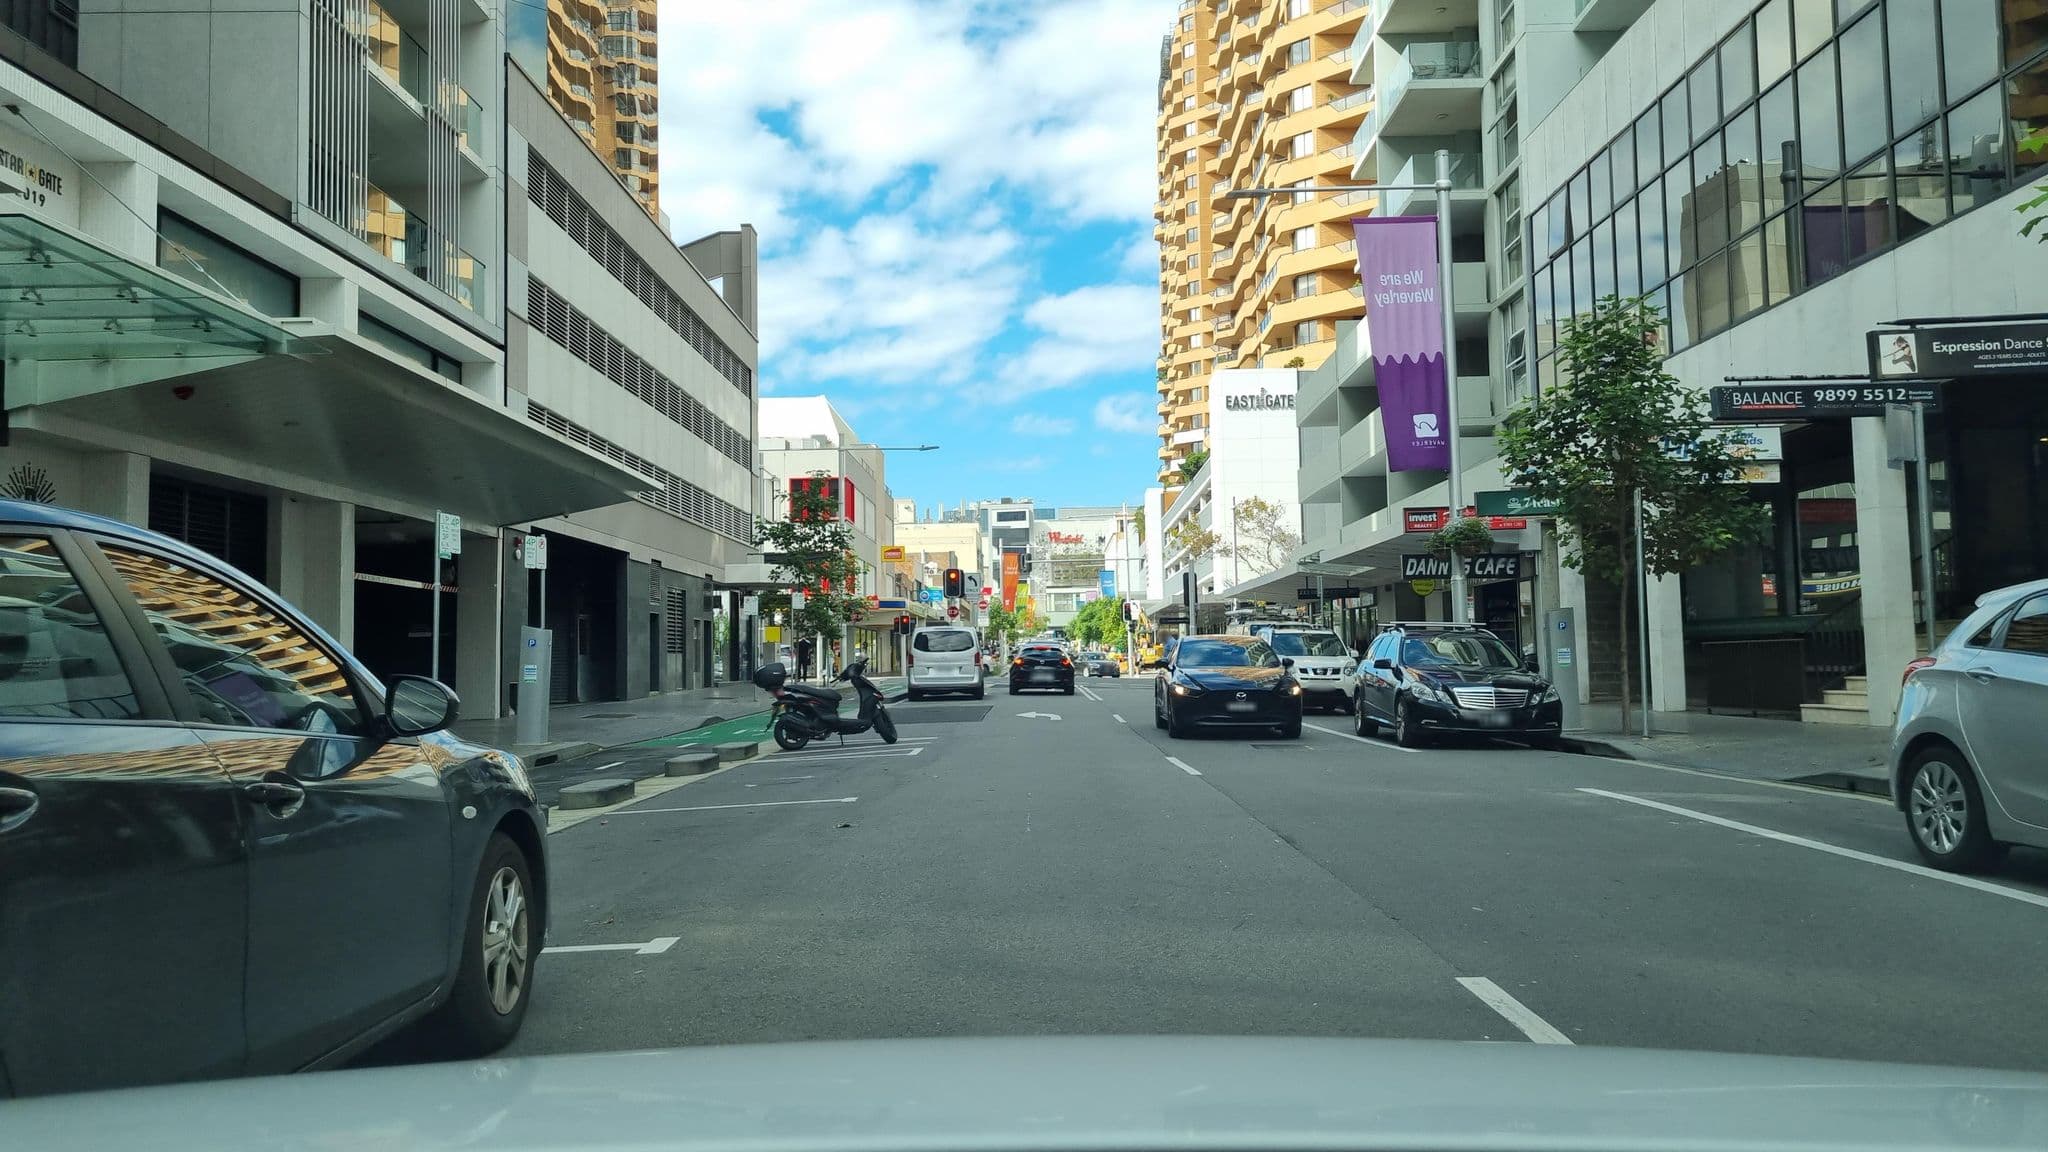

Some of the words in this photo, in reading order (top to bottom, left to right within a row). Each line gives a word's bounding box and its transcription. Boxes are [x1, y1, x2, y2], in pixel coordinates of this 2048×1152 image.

[38, 168, 63, 196] GATE
[1932, 339, 2001, 355] Expression
[2004, 338, 2043, 350] Dance
[1226, 395, 1255, 410] EAST
[1265, 394, 1295, 410] GATE
[1733, 391, 1803, 405] BALANCE
[1813, 389, 1857, 402] 9899
[1863, 388, 1906, 401] 5512
[1408, 513, 1437, 522] invest
[1475, 557, 1516, 576] CAFE
